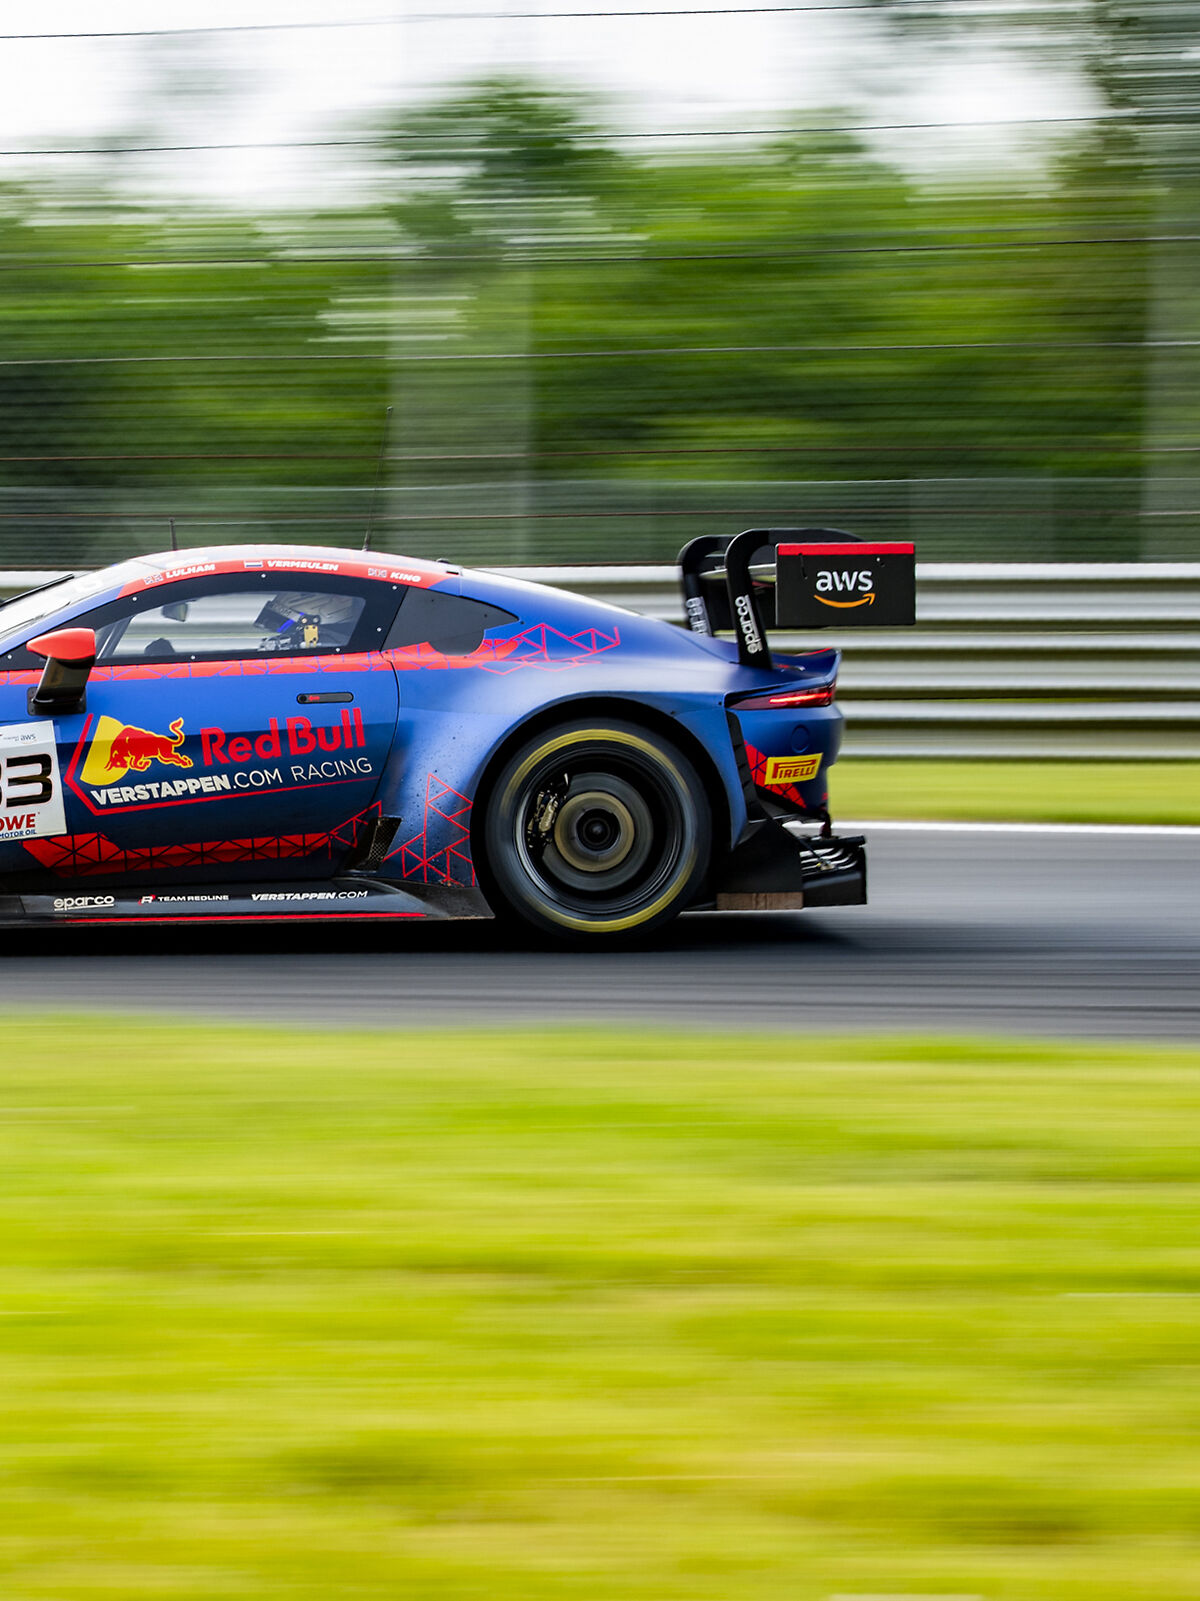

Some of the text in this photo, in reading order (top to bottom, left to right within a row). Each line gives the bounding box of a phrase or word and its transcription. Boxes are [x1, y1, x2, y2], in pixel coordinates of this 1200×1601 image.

[166, 560, 421, 582] LULHAM VERMEULEN KING
[815, 570, 873, 592] aws
[735, 595, 761, 654] sparco
[200, 707, 367, 766] Red Bull
[772, 759, 817, 780] PIRELLI
[91, 757, 373, 806] VERSTAPPEN.COM RACING
[54, 895, 115, 910] sparco
[251, 890, 368, 901] VERSTAPPEN.COM
